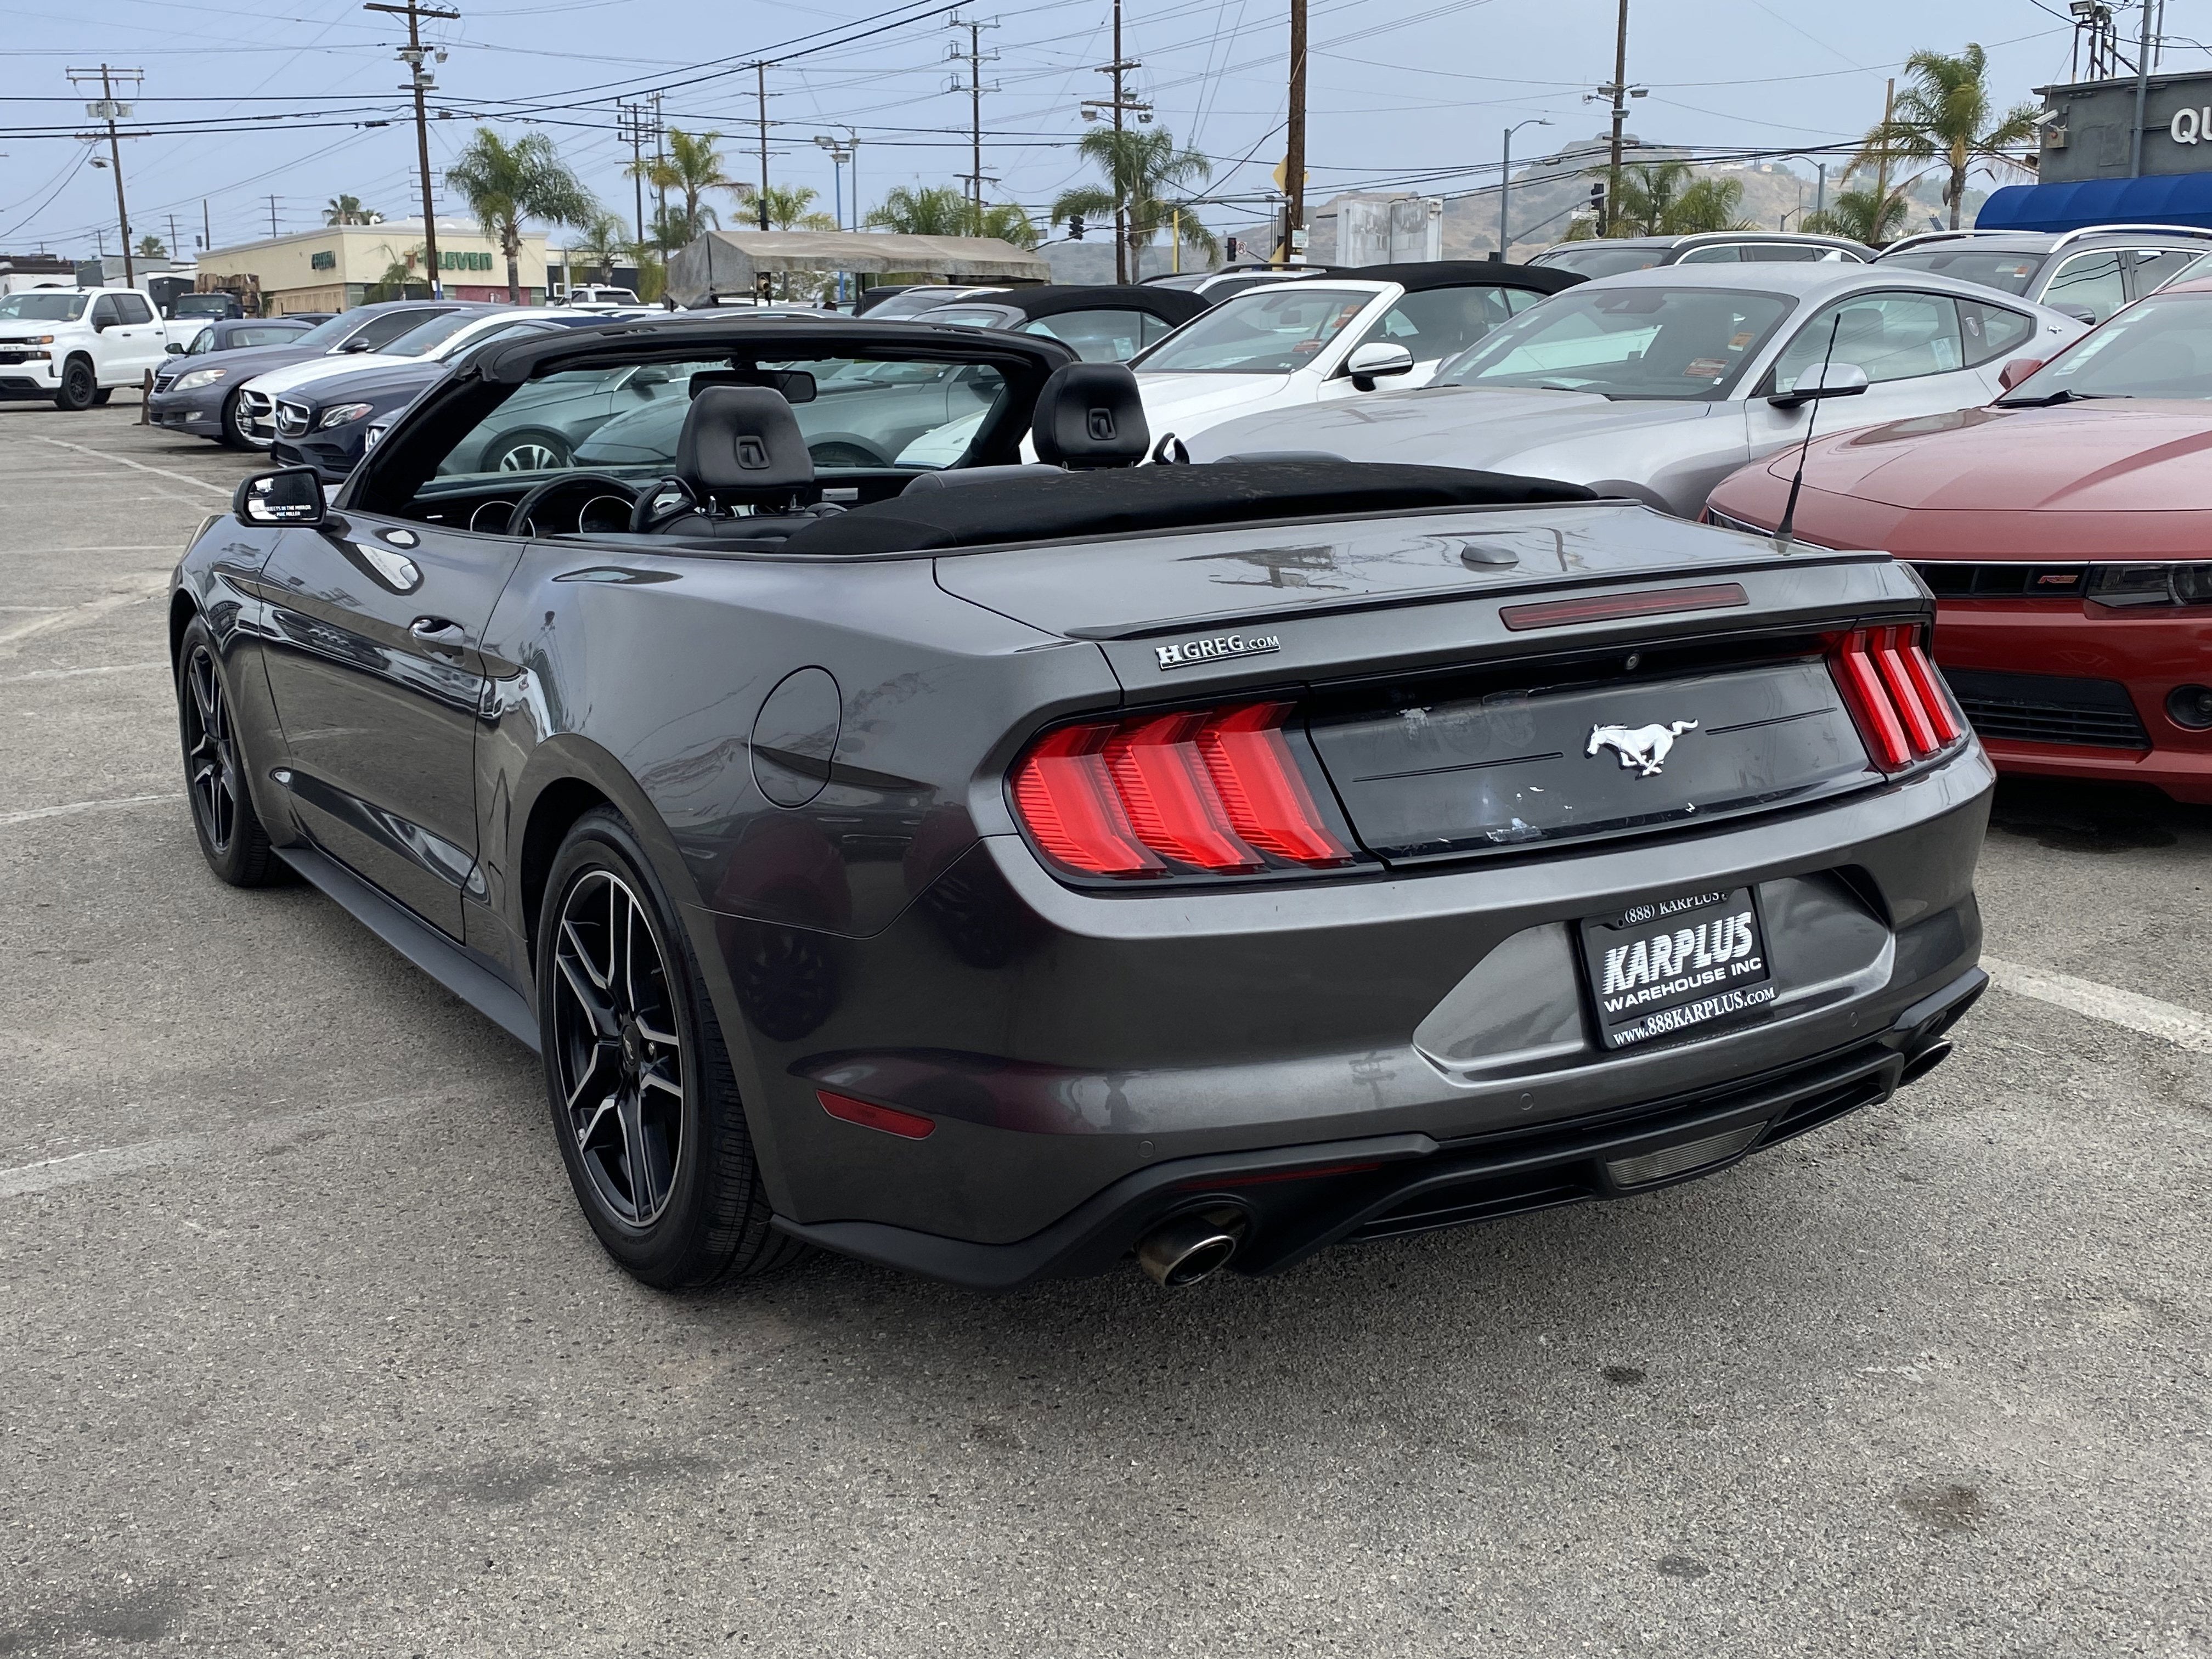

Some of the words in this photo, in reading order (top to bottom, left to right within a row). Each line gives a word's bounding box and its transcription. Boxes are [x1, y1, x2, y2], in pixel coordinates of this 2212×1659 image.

[1624, 904, 1655, 924] (888)
[1660, 892, 1719, 915] KARPLUS
[1601, 912, 1752, 995] KARPLUS
[1604, 967, 1726, 1012] WAREHOUSE
[1731, 957, 1762, 976] INC
